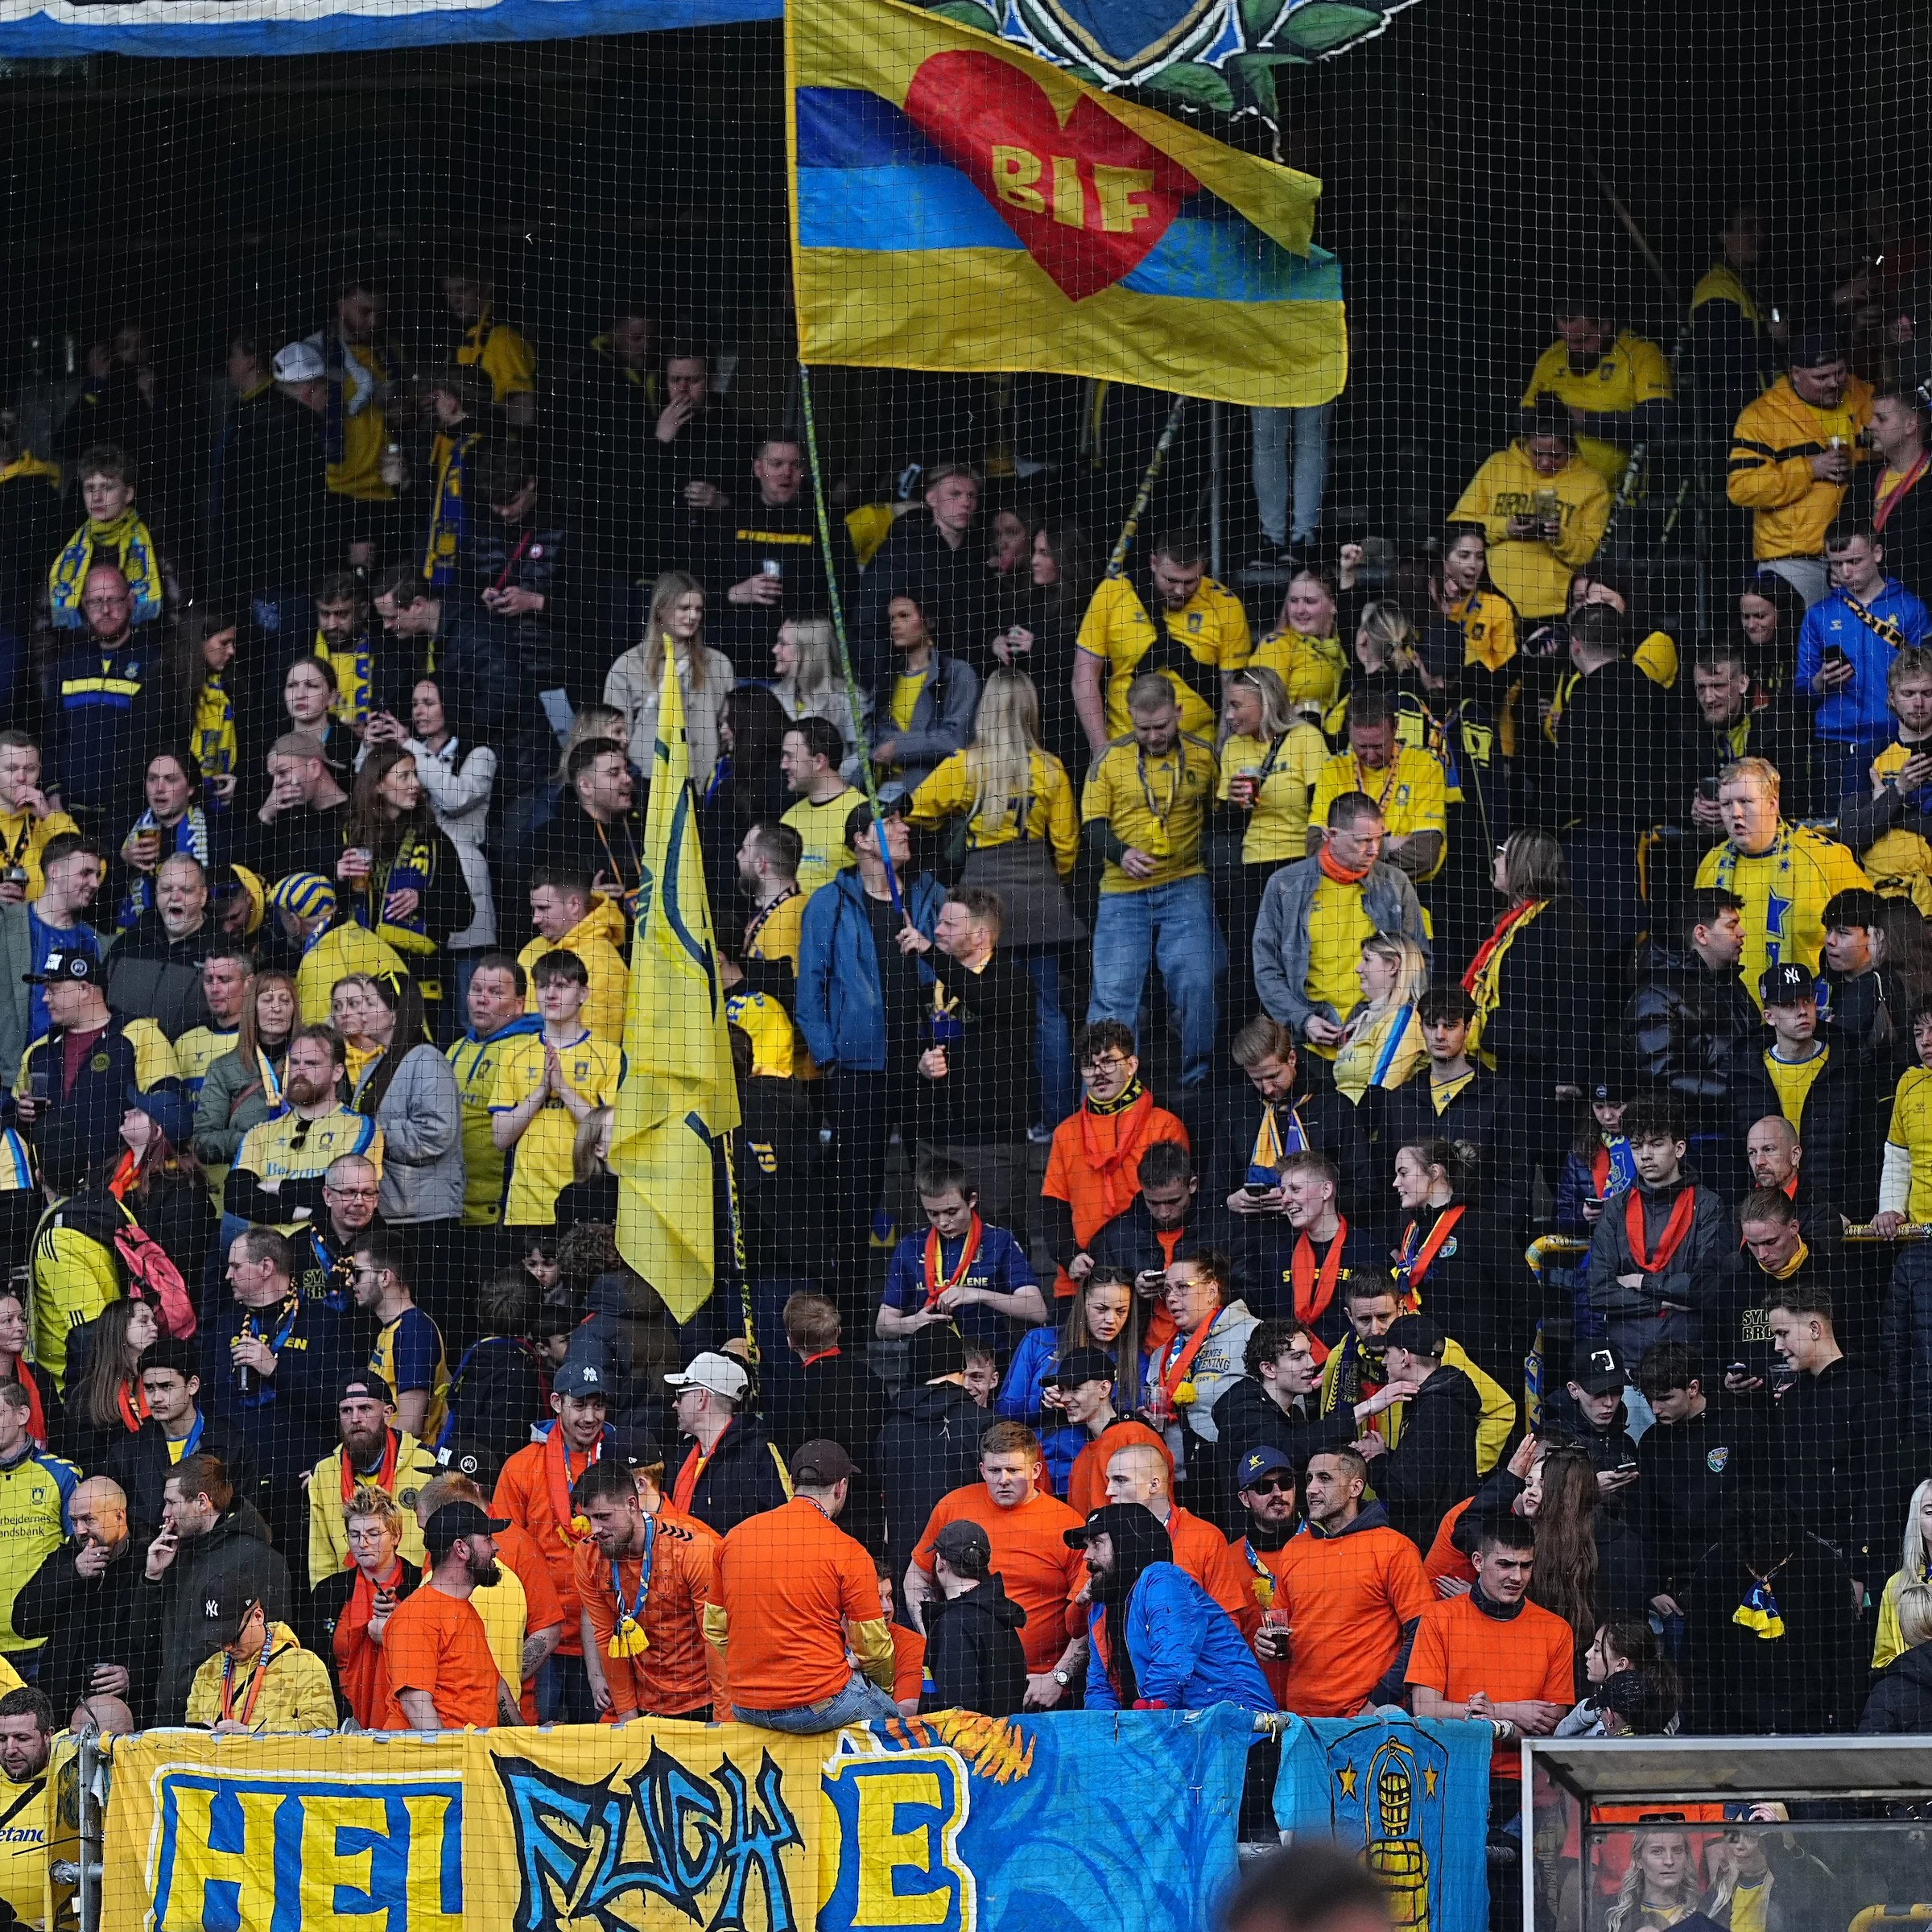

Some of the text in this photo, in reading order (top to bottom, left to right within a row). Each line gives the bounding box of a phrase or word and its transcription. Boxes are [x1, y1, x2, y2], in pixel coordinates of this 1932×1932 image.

[991, 145, 1154, 233] BIF
[1784, 967, 1801, 984] NY
[583, 1366, 598, 1382] NY
[205, 1599, 219, 1617] NY
